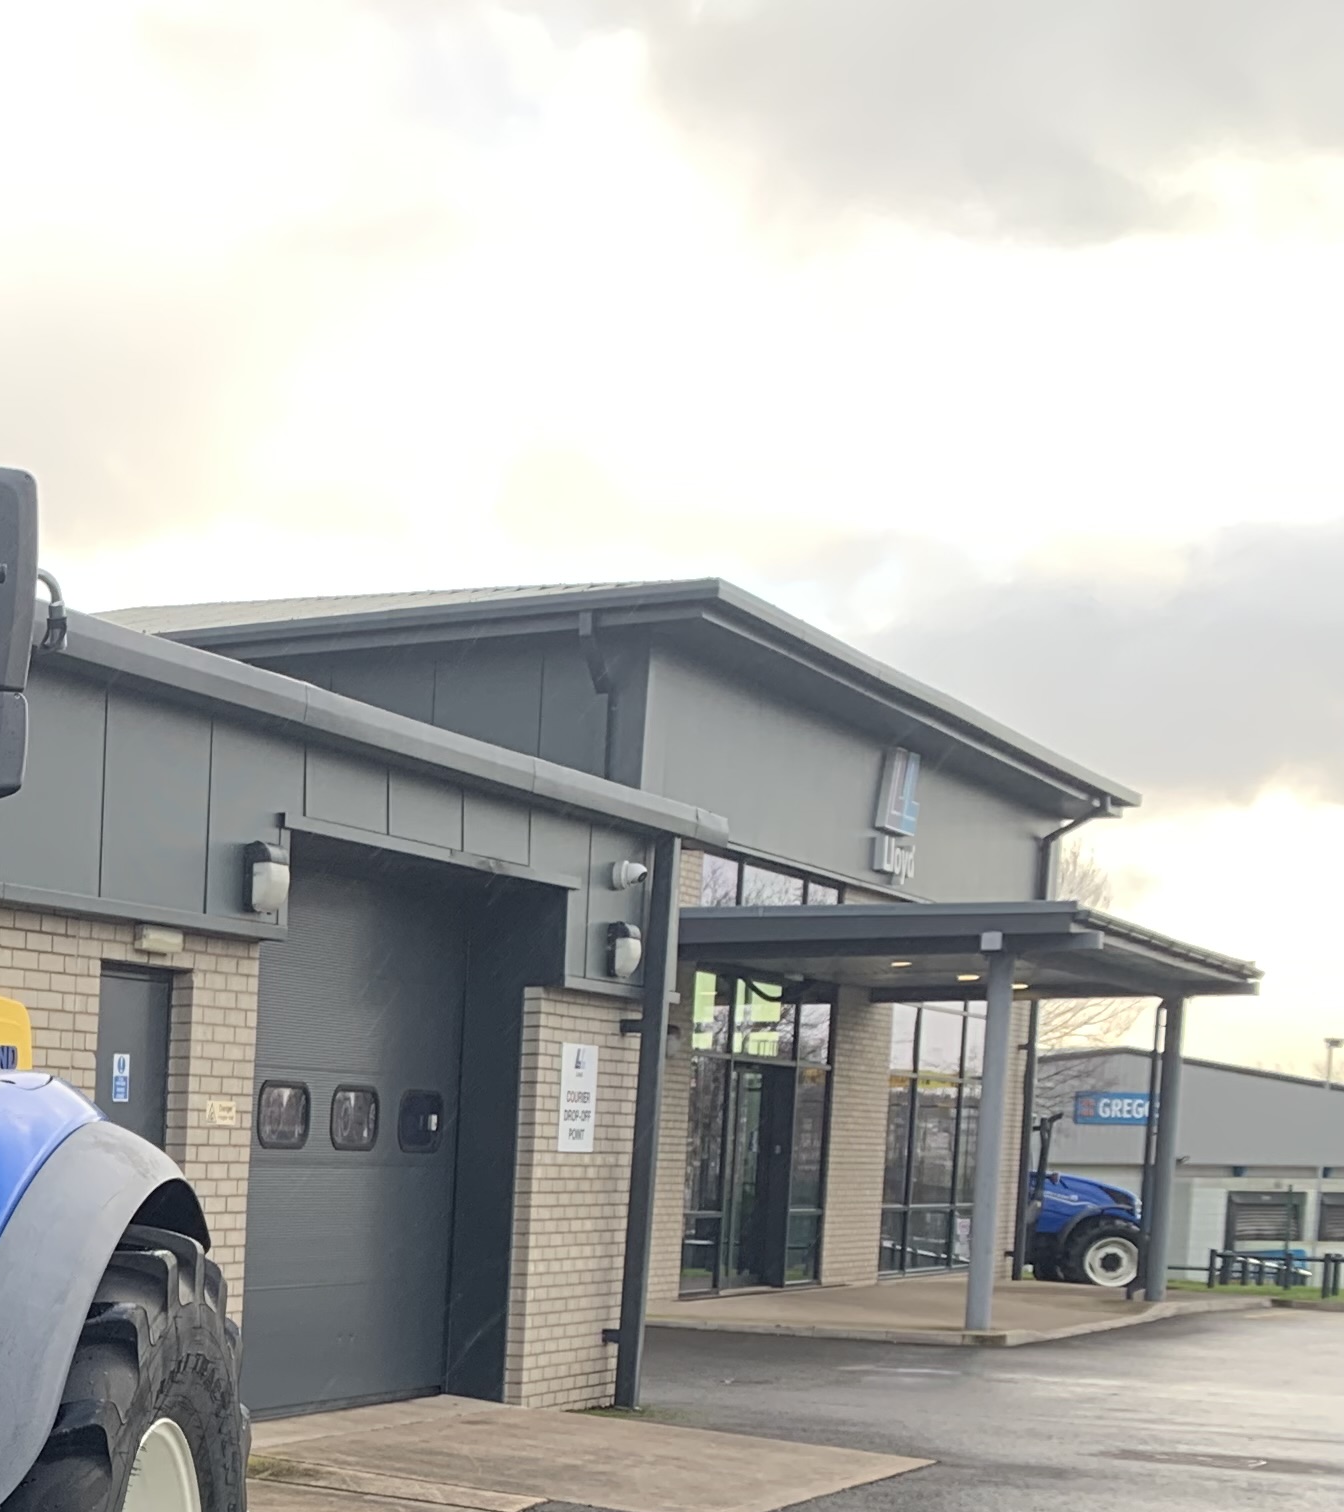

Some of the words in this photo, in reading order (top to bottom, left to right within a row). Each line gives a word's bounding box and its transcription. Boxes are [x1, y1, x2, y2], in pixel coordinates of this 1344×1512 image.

[882, 835, 916, 885] Lloyd
[566, 1090, 591, 1104] COURIER
[1098, 1097, 1150, 1119] GREG
[563, 1109, 592, 1122] DROP-OFF
[568, 1128, 586, 1140] POINT
